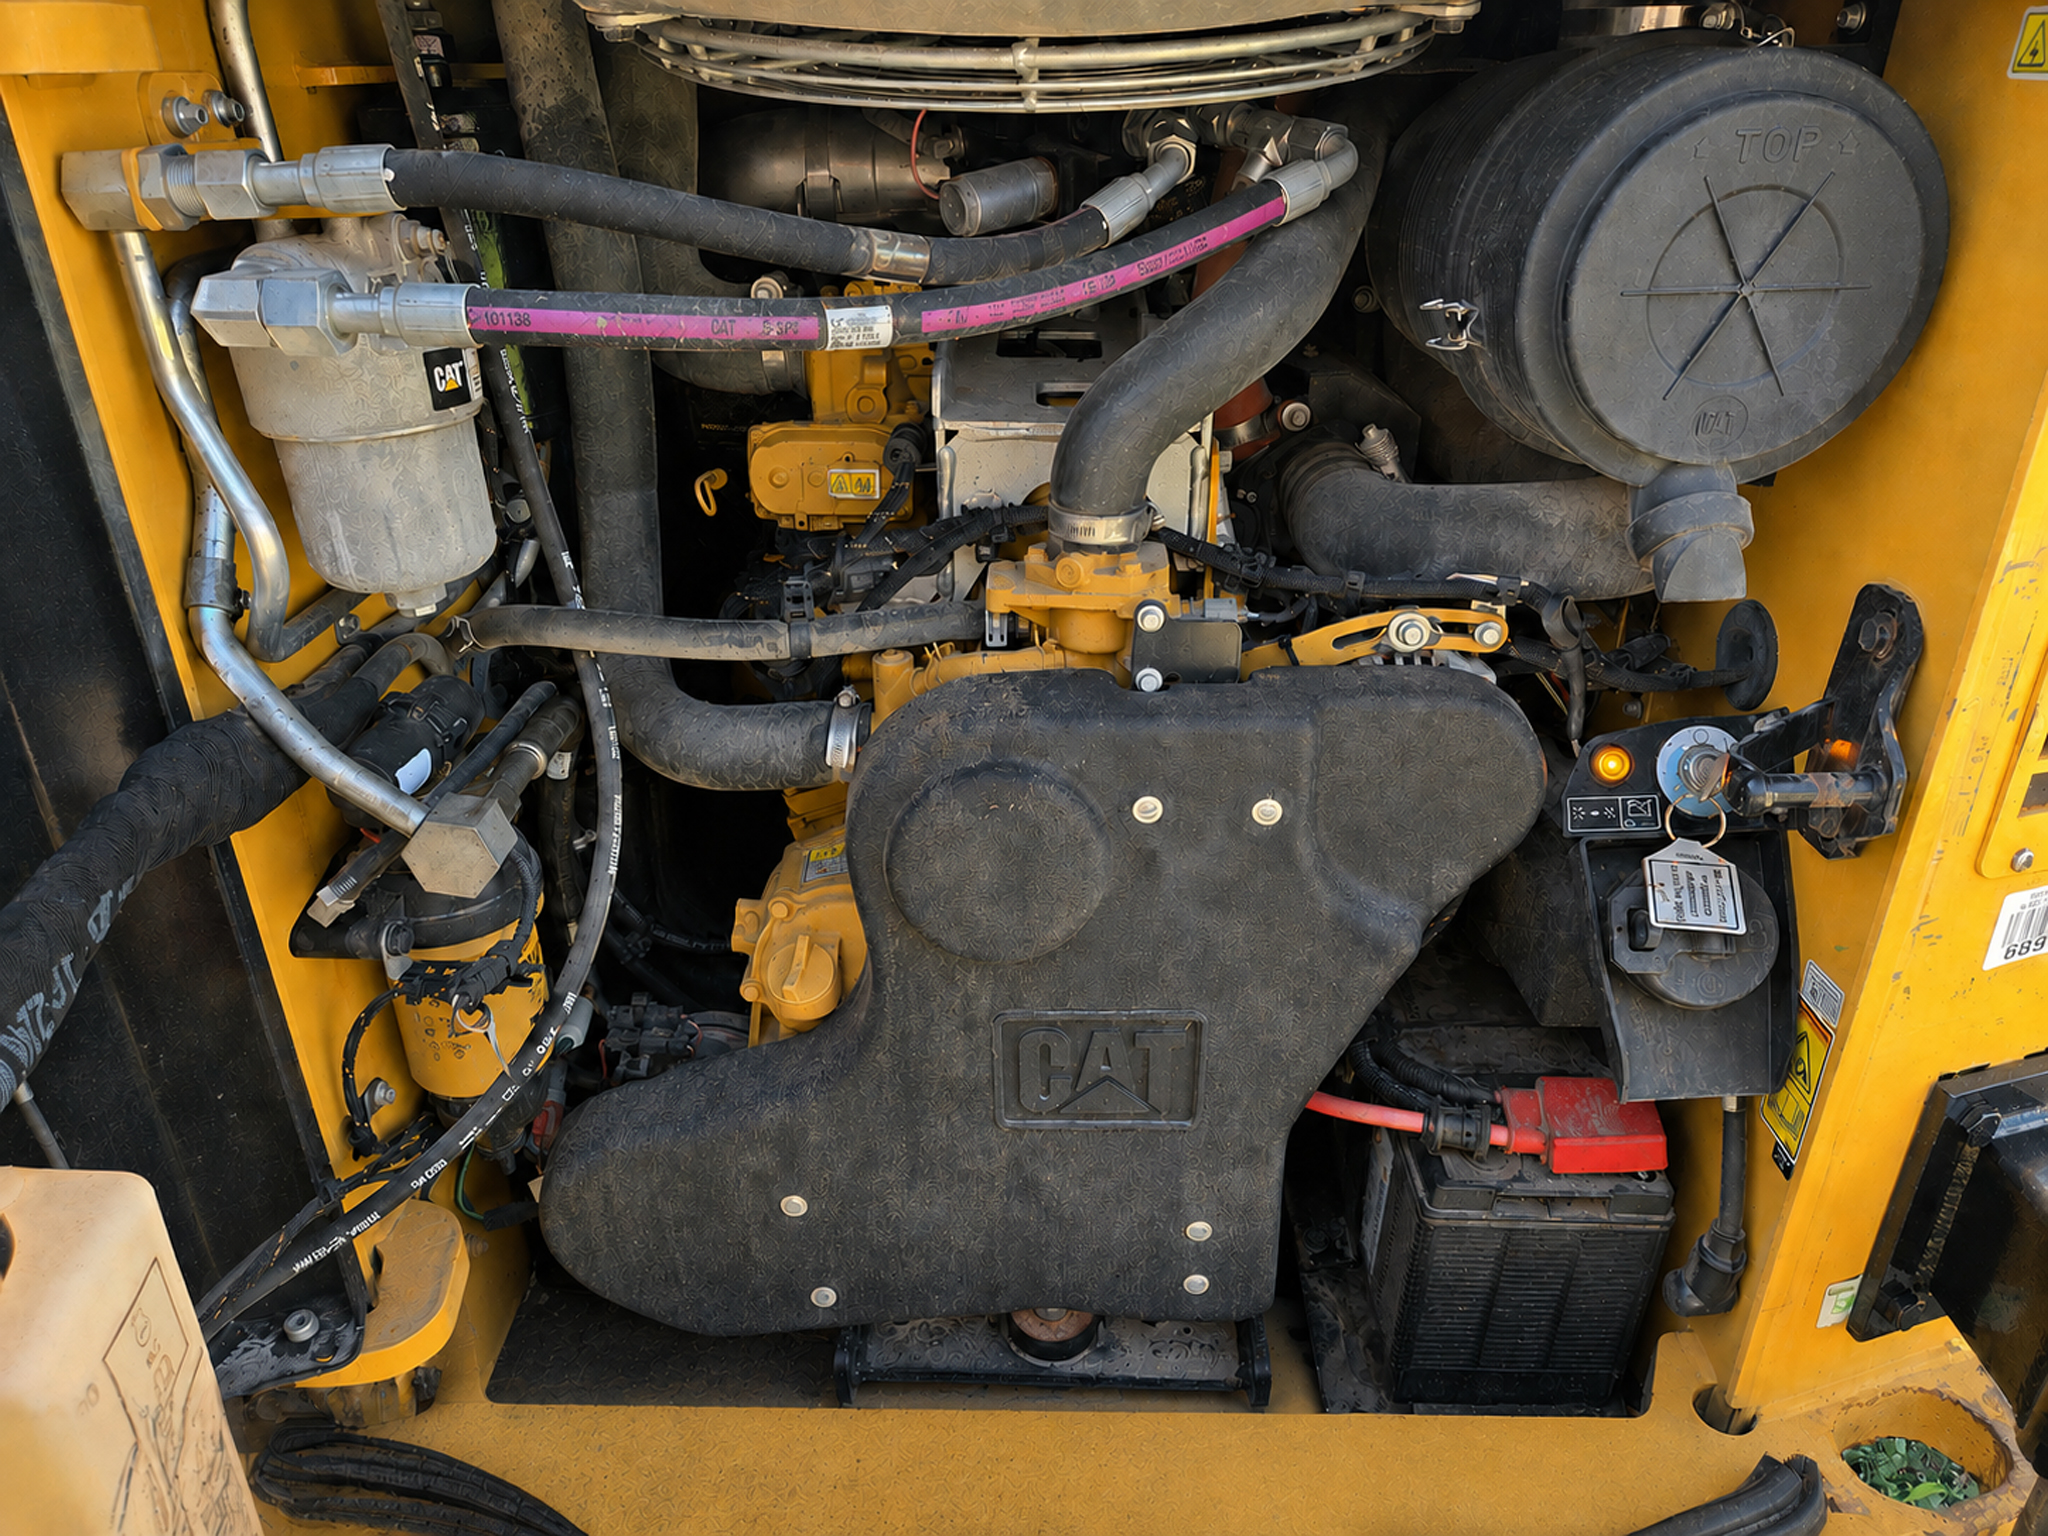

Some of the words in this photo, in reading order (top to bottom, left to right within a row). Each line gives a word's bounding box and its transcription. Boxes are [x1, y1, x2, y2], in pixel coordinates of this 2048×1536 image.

[1736, 125, 1823, 164] TOP
[484, 311, 531, 327] 101138
[711, 319, 737, 336] CAT
[433, 360, 464, 392] CAT
[2003, 935, 2047, 960] 689
[1018, 1026, 1188, 1114] CAT
